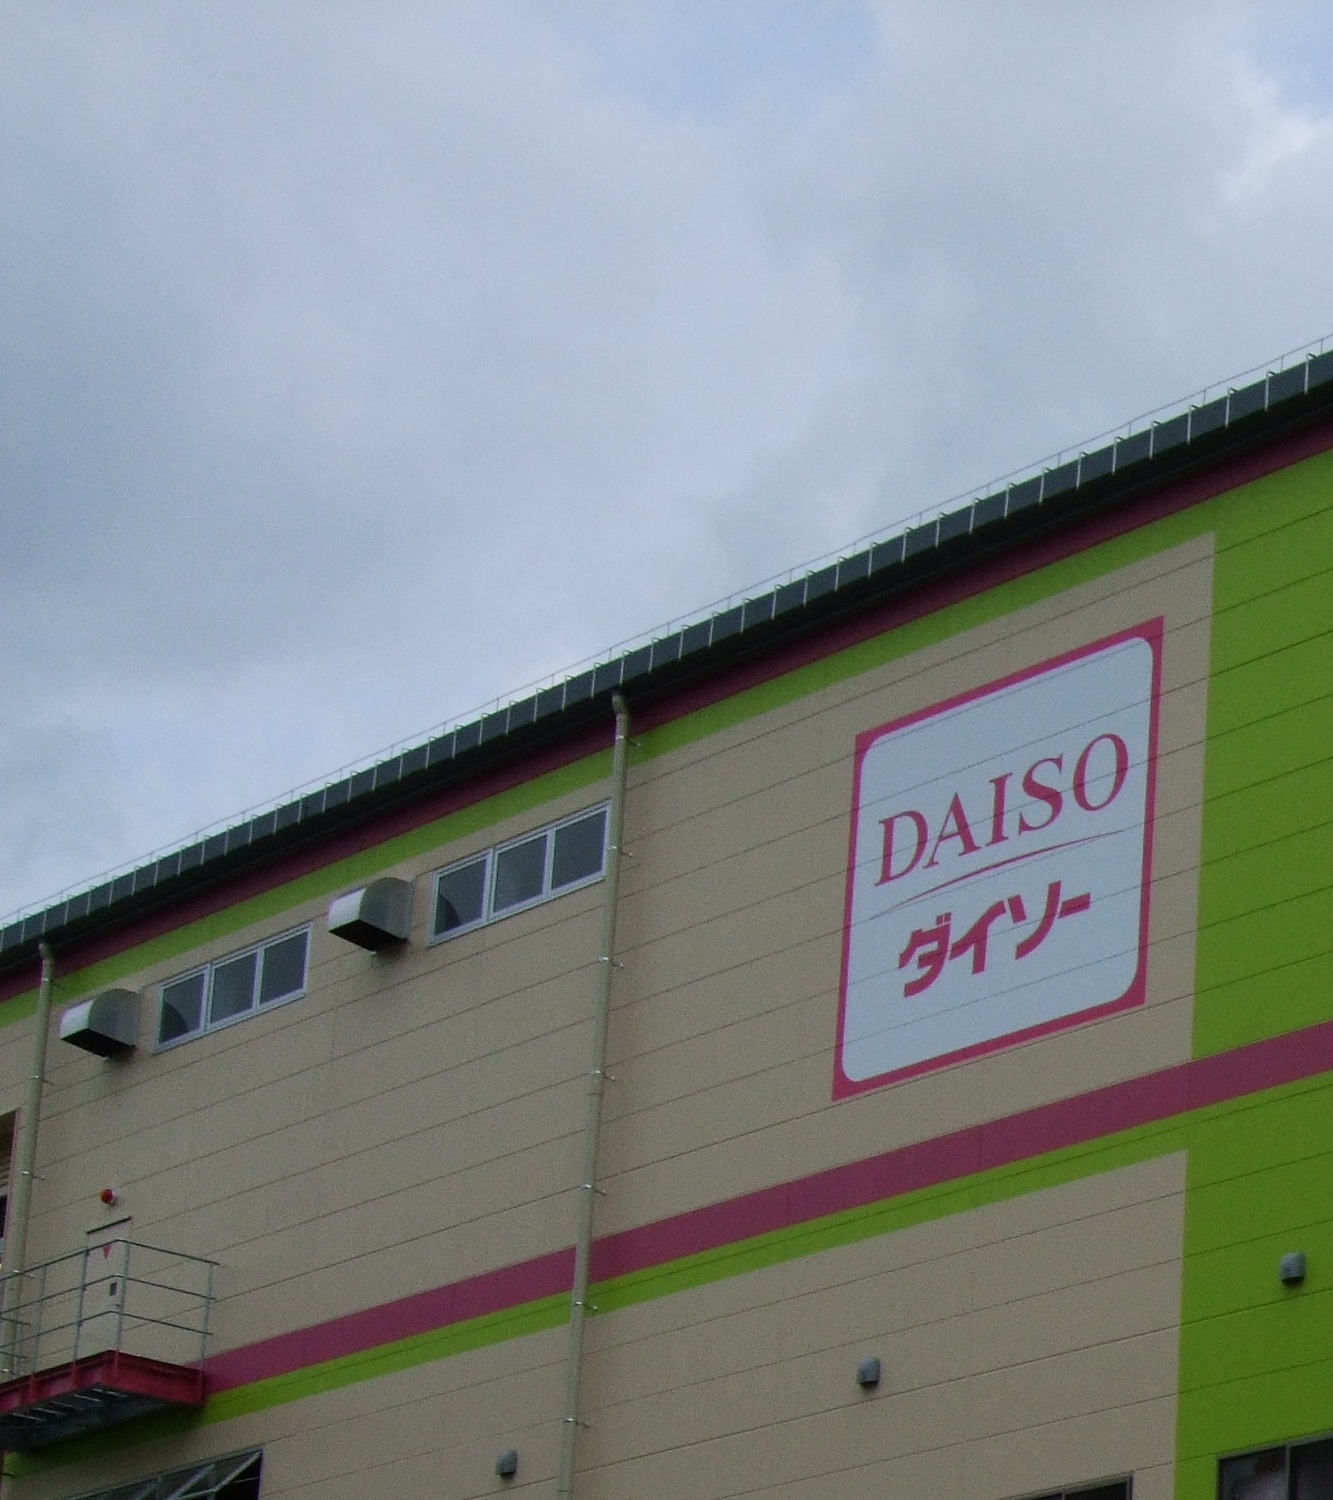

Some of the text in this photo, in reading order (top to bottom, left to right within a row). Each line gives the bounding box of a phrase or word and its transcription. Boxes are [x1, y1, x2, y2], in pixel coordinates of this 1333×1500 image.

[874, 733, 1129, 887] DAISO
[899, 880, 1091, 999] ダイソー
